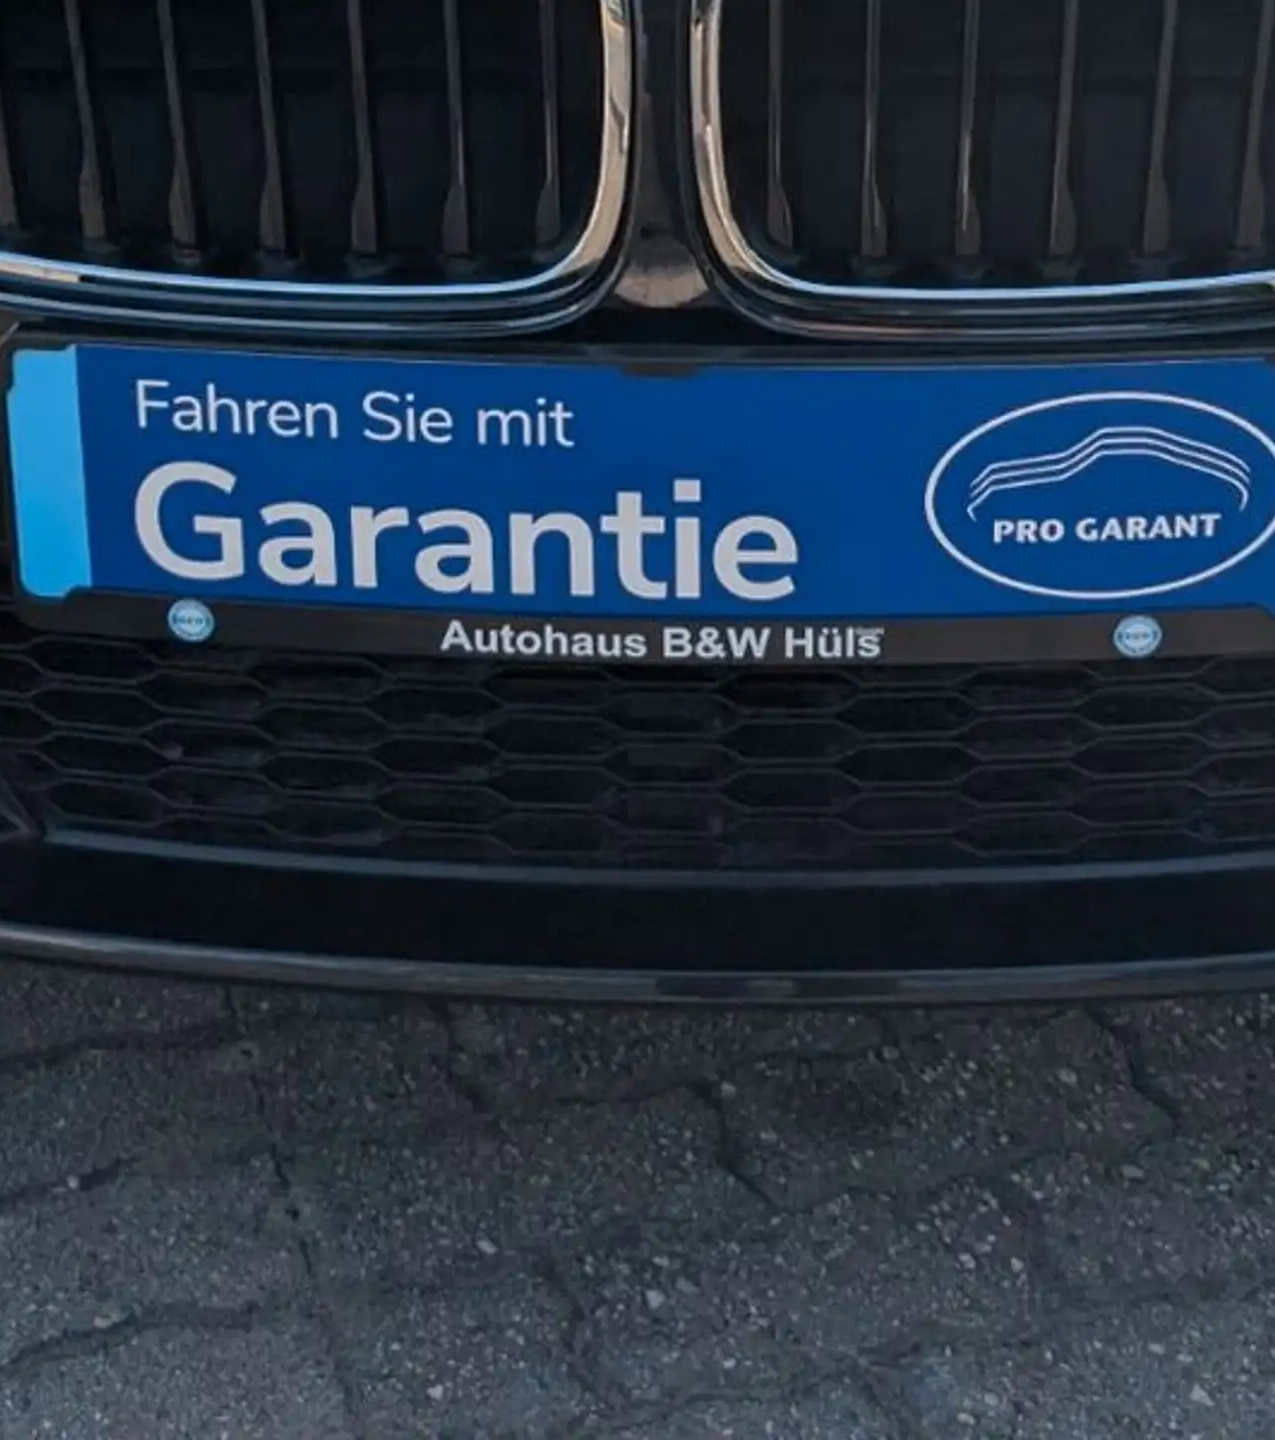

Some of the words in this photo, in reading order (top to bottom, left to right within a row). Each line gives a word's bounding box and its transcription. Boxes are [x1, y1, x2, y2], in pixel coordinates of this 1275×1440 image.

[135, 378, 340, 440] Fahren
[362, 390, 454, 445] Sie
[477, 396, 575, 448] mit
[134, 460, 799, 601] Garantie
[992, 517, 1066, 545] PRO
[1074, 512, 1223, 544] GARANT
[439, 619, 649, 659] Autohaus
[663, 626, 772, 660] B&W
[784, 626, 882, 660] Hüls
